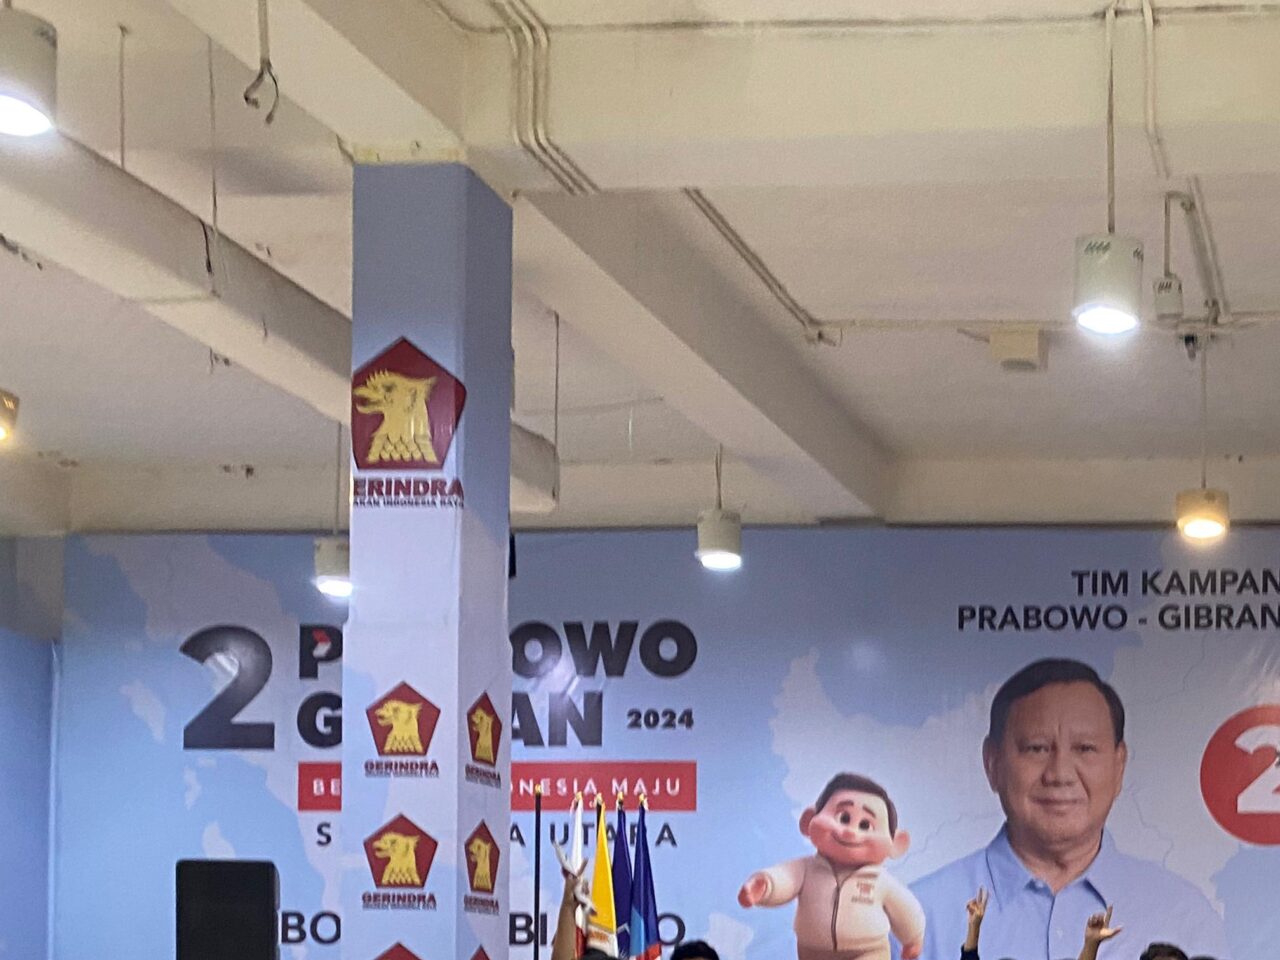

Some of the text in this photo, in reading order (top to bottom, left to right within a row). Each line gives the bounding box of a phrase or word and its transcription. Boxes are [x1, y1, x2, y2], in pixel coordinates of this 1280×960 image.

[353, 476, 465, 498] ERINDRA
[1071, 569, 1129, 596] TIM
[957, 604, 1128, 632] PRABOWO
[178, 623, 276, 750] 2
[627, 707, 694, 730] 2024
[364, 759, 439, 772] GERINDRA
[611, 776, 682, 797] MAJU
[362, 891, 437, 904] GERINDRA
